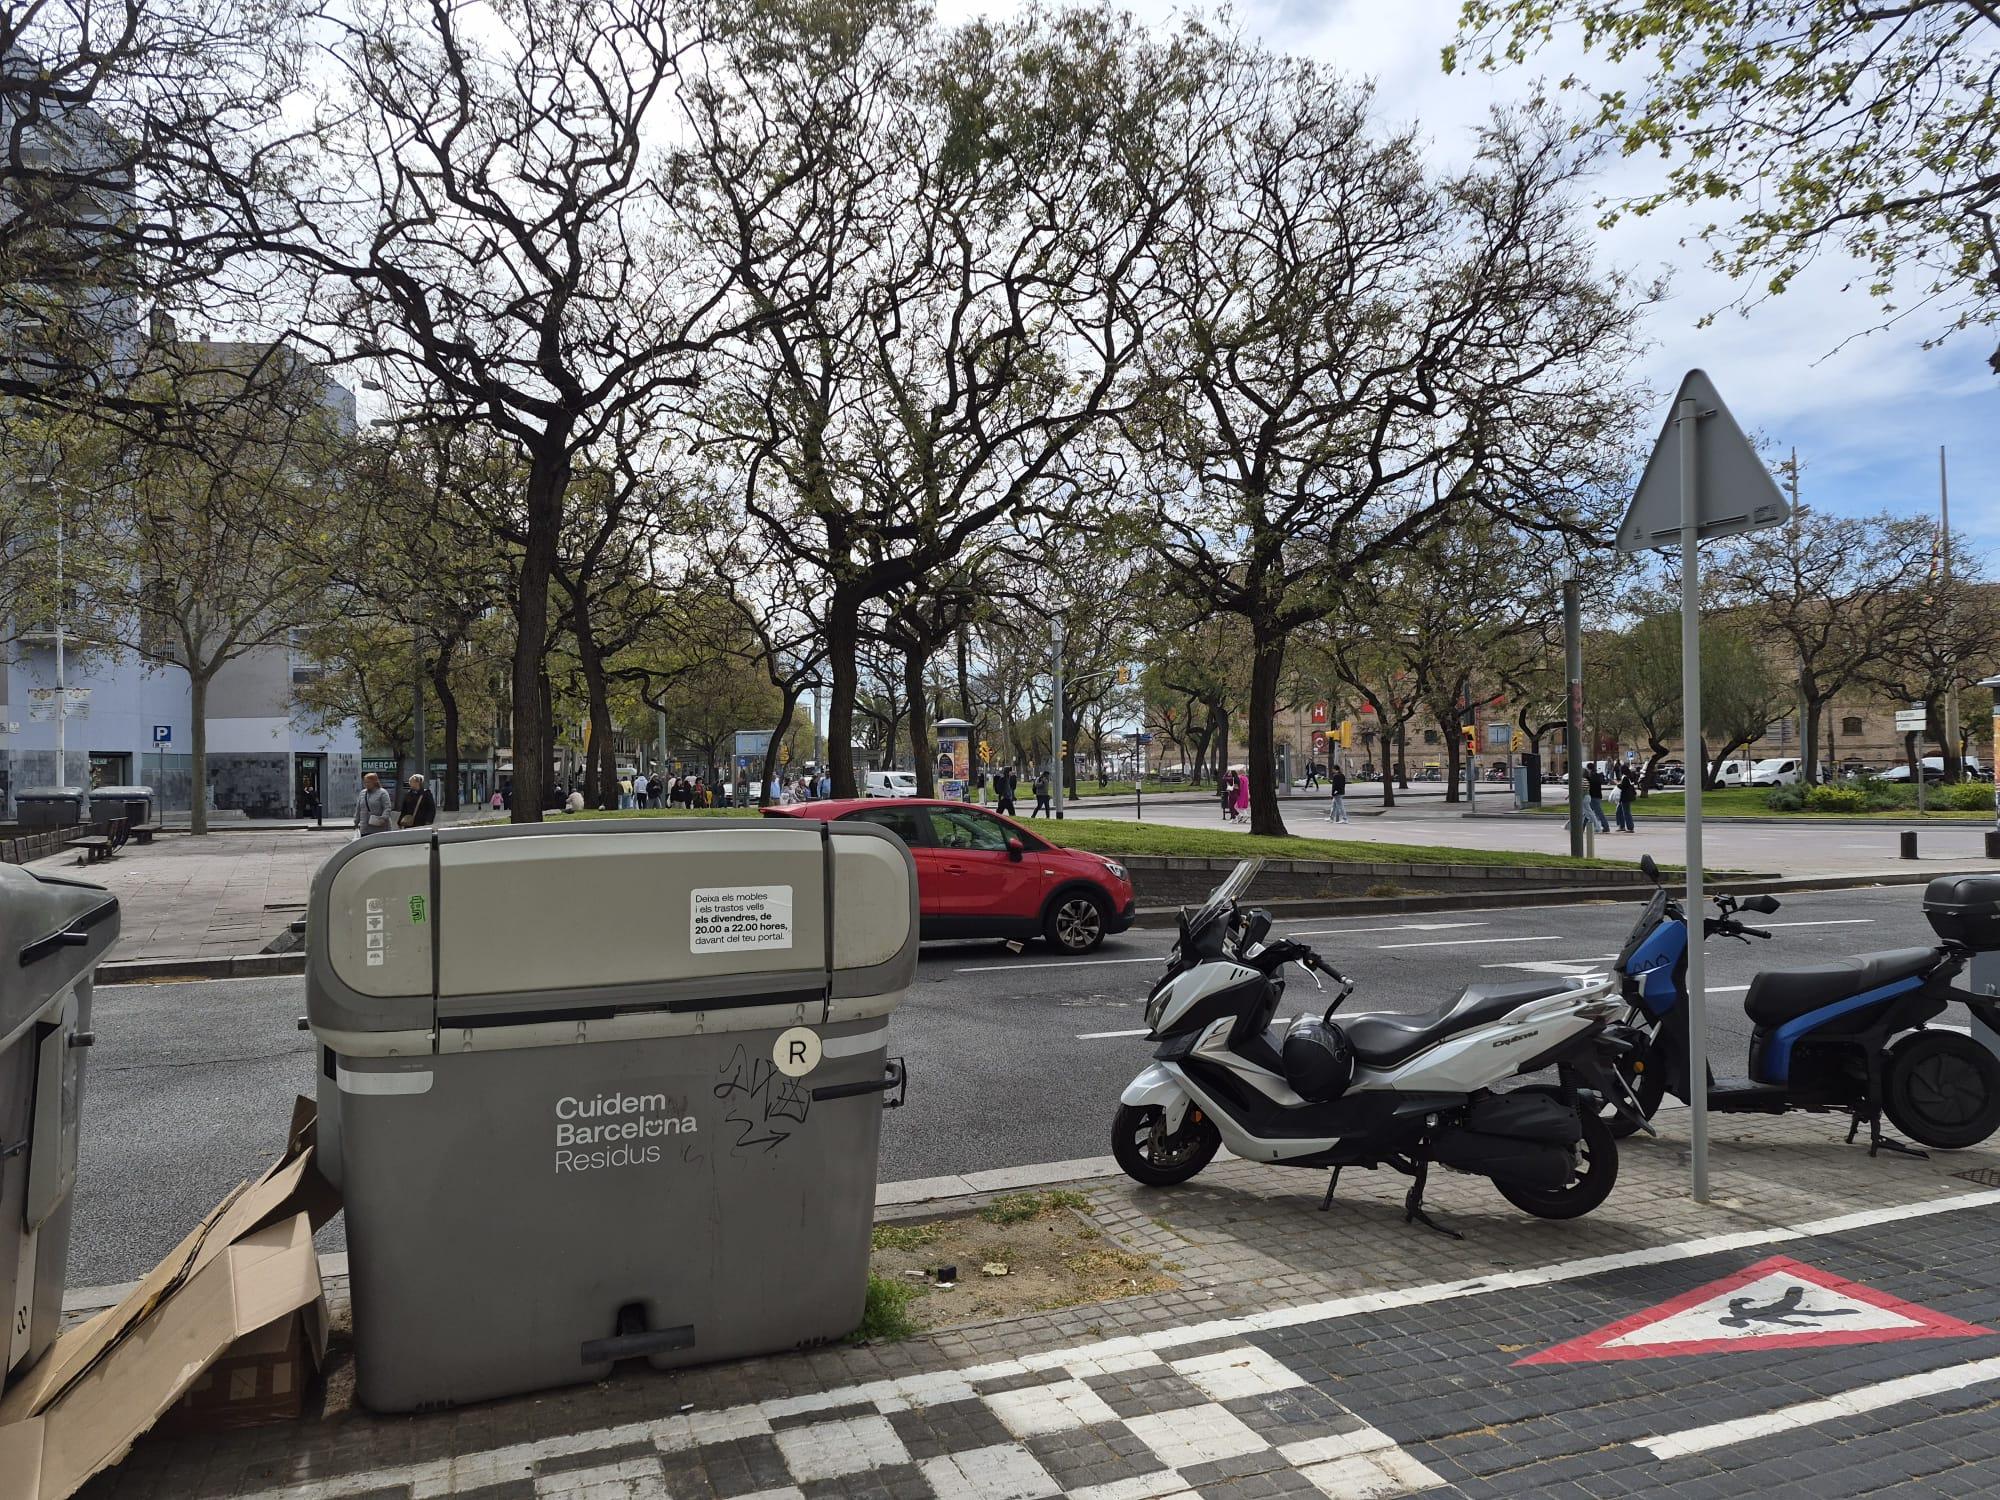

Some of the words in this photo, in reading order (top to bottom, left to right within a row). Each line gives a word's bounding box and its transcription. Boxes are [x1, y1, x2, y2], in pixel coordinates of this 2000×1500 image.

[1315, 706, 1323, 717] H
[156, 727, 168, 741] P
[695, 894, 719, 903] Deixa
[736, 892, 768, 901] mobles
[700, 905, 712, 913] els
[714, 903, 744, 912] trastos
[746, 902, 764, 911] vells
[711, 913, 758, 923] divendres,
[760, 912, 772, 920] de
[695, 925, 722, 934] 20.00
[732, 923, 758, 932] 22.00
[760, 922, 788, 931] hores,
[695, 936, 724, 945] davant
[726, 934, 740, 943] del
[741, 934, 756, 942] teu
[758, 932, 784, 943] portal.
[789, 1040, 807, 1065] R
[555, 1092, 666, 1120] Cuidem
[556, 1115, 698, 1147] Barcelona
[555, 1143, 661, 1174] Residus
